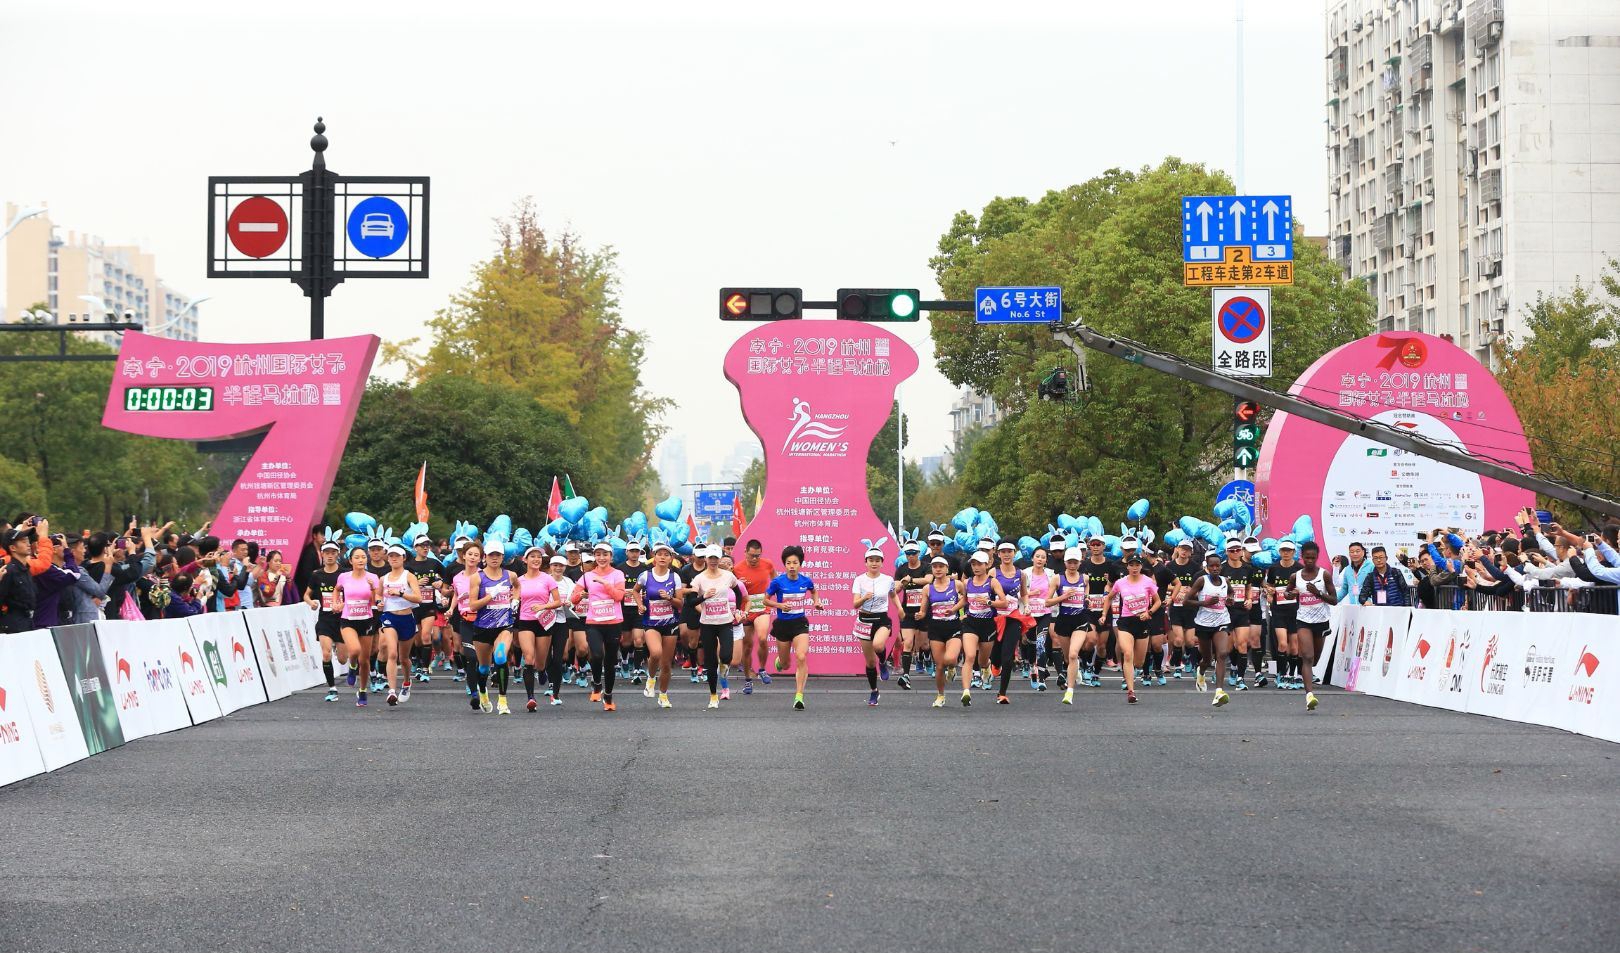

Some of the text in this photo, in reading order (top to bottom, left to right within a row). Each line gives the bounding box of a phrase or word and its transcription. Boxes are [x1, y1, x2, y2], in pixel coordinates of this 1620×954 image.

[1203, 247, 1208, 258] 1
[1233, 250, 1243, 262] 2
[1267, 246, 1276, 257] 3
[1187, 265, 1290, 281] 工程车走第2车道
[1000, 292, 1058, 308] 6号大街
[1217, 350, 1267, 369] 全路段
[127, 388, 212, 410] 0:00:03
[776, 508, 857, 516] 杭州钱塘新区管理委员会
